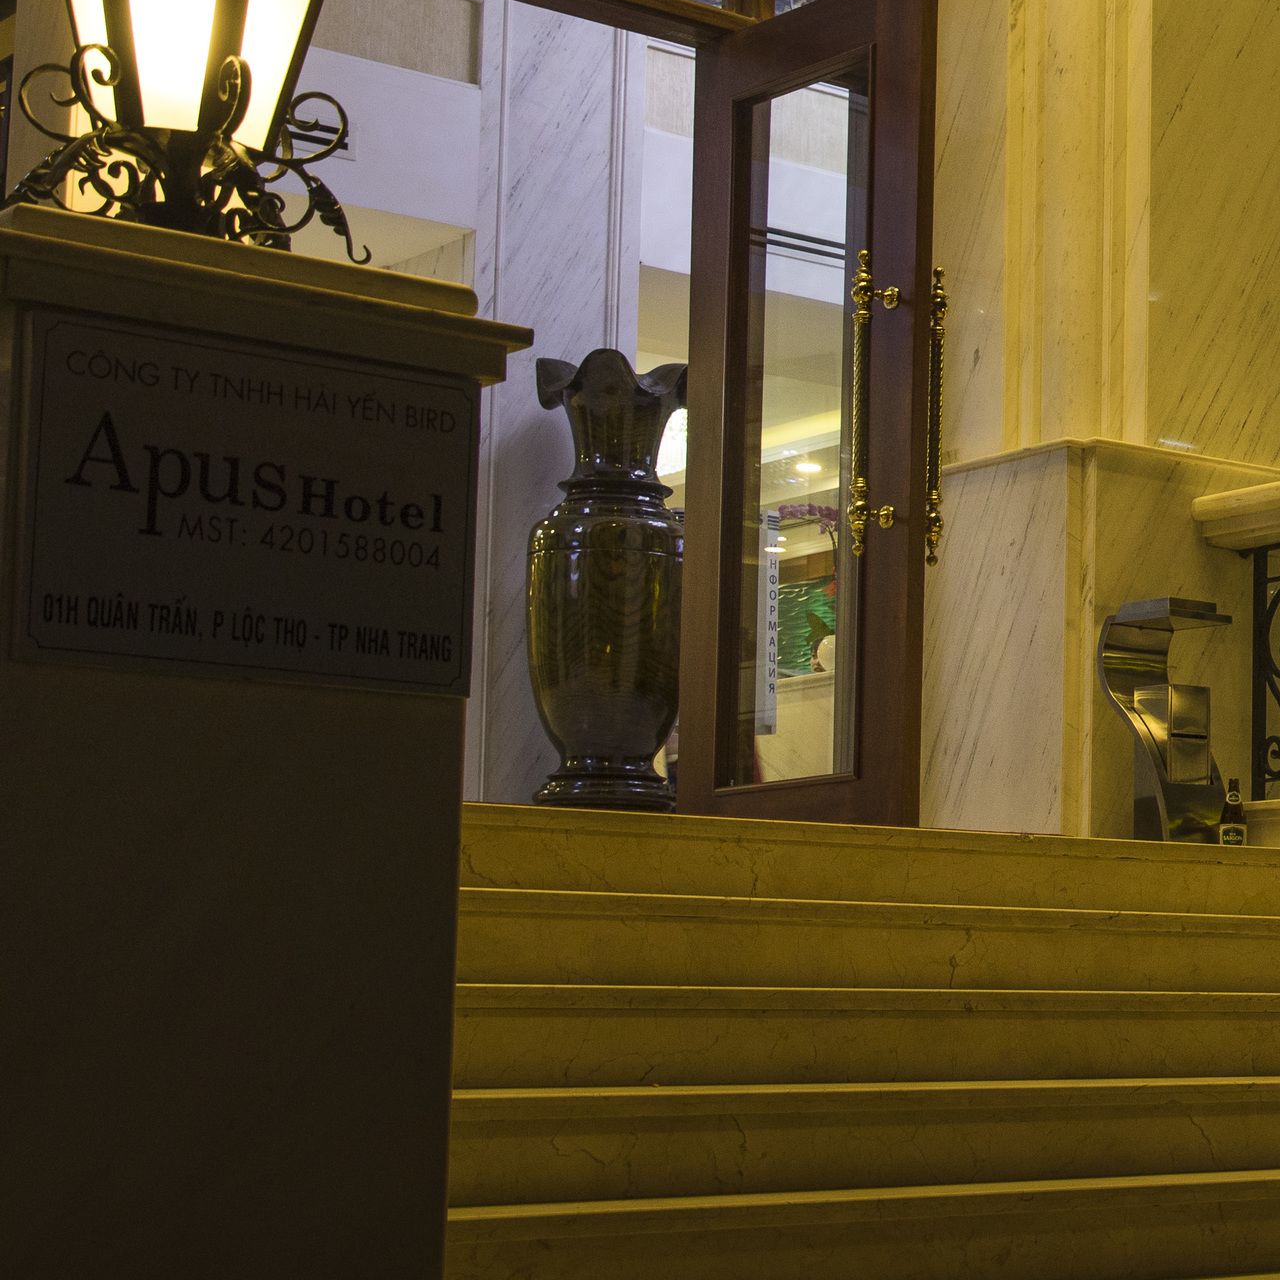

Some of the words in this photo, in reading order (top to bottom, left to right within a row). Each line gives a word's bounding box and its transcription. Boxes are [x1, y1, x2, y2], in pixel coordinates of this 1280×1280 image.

[65, 349, 161, 388] CÔNG
[171, 365, 200, 393] TY
[209, 372, 284, 406] TNHH
[294, 383, 338, 416] HẢI
[346, 391, 396, 424] YẾN
[405, 405, 456, 433] BIRD
[63, 410, 288, 536] Apus
[296, 474, 445, 533] Hotel
[177, 512, 248, 547] MST:
[260, 524, 441, 570] 4201588004
[42, 592, 79, 626] 01H
[87, 592, 139, 631] QUÂN
[212, 610, 225, 640] P
[231, 606, 266, 648] LỘC
[273, 616, 307, 653] THỌ
[327, 622, 349, 652] TP
[355, 626, 390, 657] NHA
[397, 630, 452, 663] TRANG
